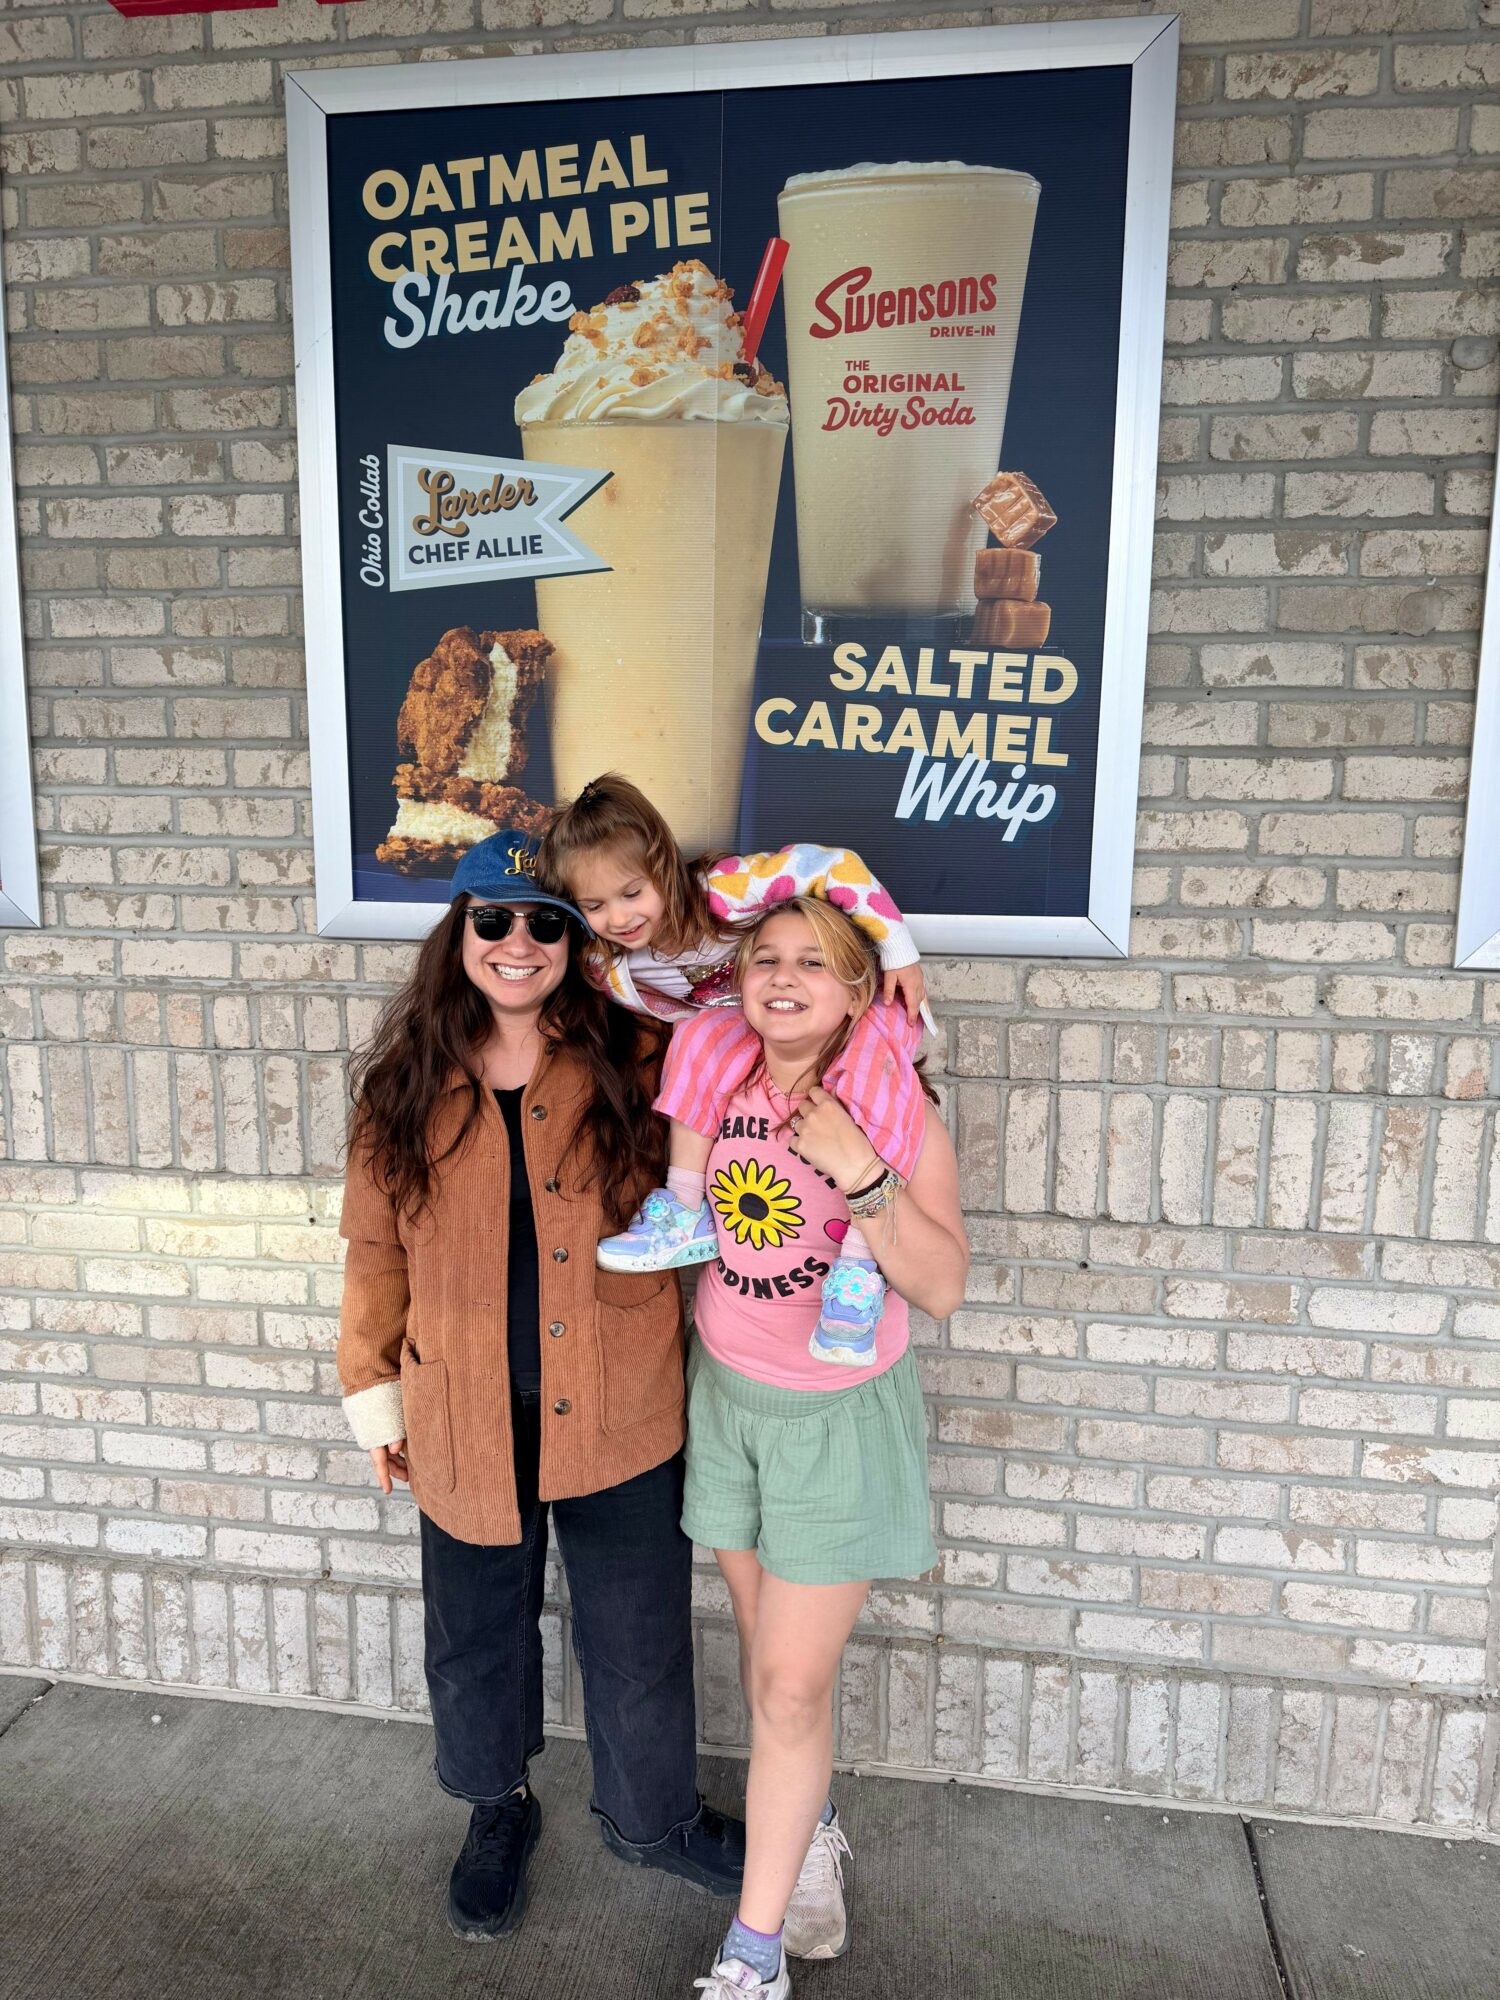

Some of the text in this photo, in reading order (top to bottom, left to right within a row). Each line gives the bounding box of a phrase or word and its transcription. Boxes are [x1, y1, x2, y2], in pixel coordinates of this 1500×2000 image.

[362, 134, 668, 220] OATMEAL
[368, 192, 711, 282] CREAM PIE
[383, 264, 577, 349] Shake
[809, 266, 998, 339] Swensons
[930, 325, 996, 338] DRIVE-IN
[843, 373, 965, 393] ORIGINAL
[845, 360, 870, 371] THE
[821, 395, 976, 437] Dirty Soda
[358, 454, 385, 587] Ohio Collab
[412, 467, 538, 537] Larder
[408, 534, 543, 565] CHEF ALLIE
[829, 642, 1078, 705] SALTED
[754, 697, 1069, 767] CARAMEL
[894, 748, 1056, 842] Whip
[718, 1116, 769, 1141] EACE
